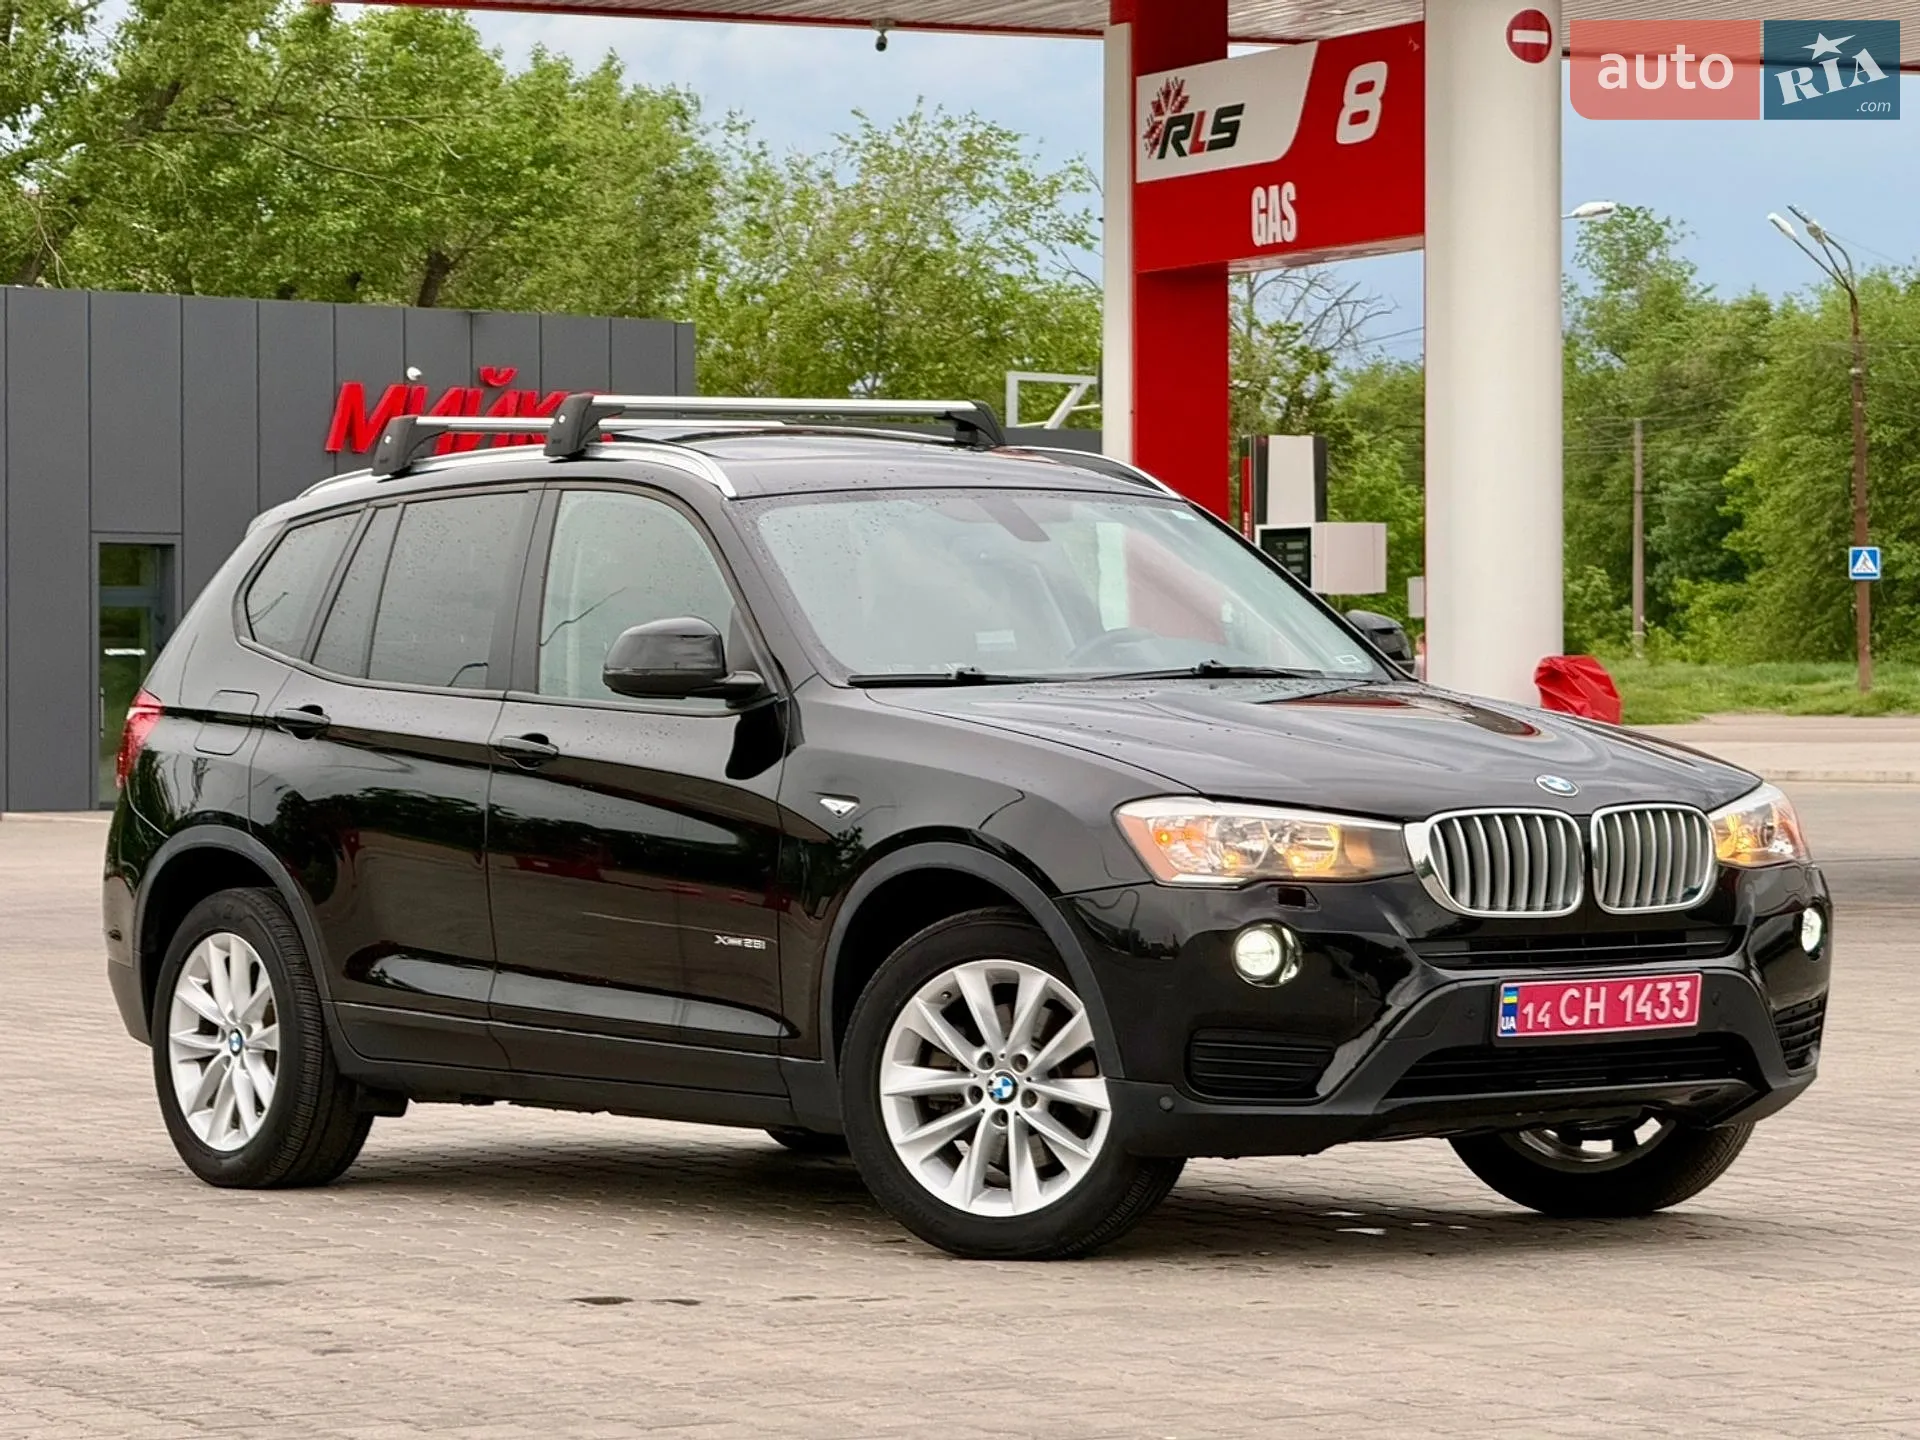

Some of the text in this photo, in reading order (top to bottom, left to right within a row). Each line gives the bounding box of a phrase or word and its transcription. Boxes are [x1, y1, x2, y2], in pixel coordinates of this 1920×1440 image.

[1157, 103, 1245, 159] RLS
[1336, 61, 1388, 145] 8
[1251, 181, 1297, 247] GAS
[325, 366, 614, 455] МИЙК
[1501, 1016, 1516, 1031] UA
[1522, 981, 1691, 1030] 14 CH 1433
